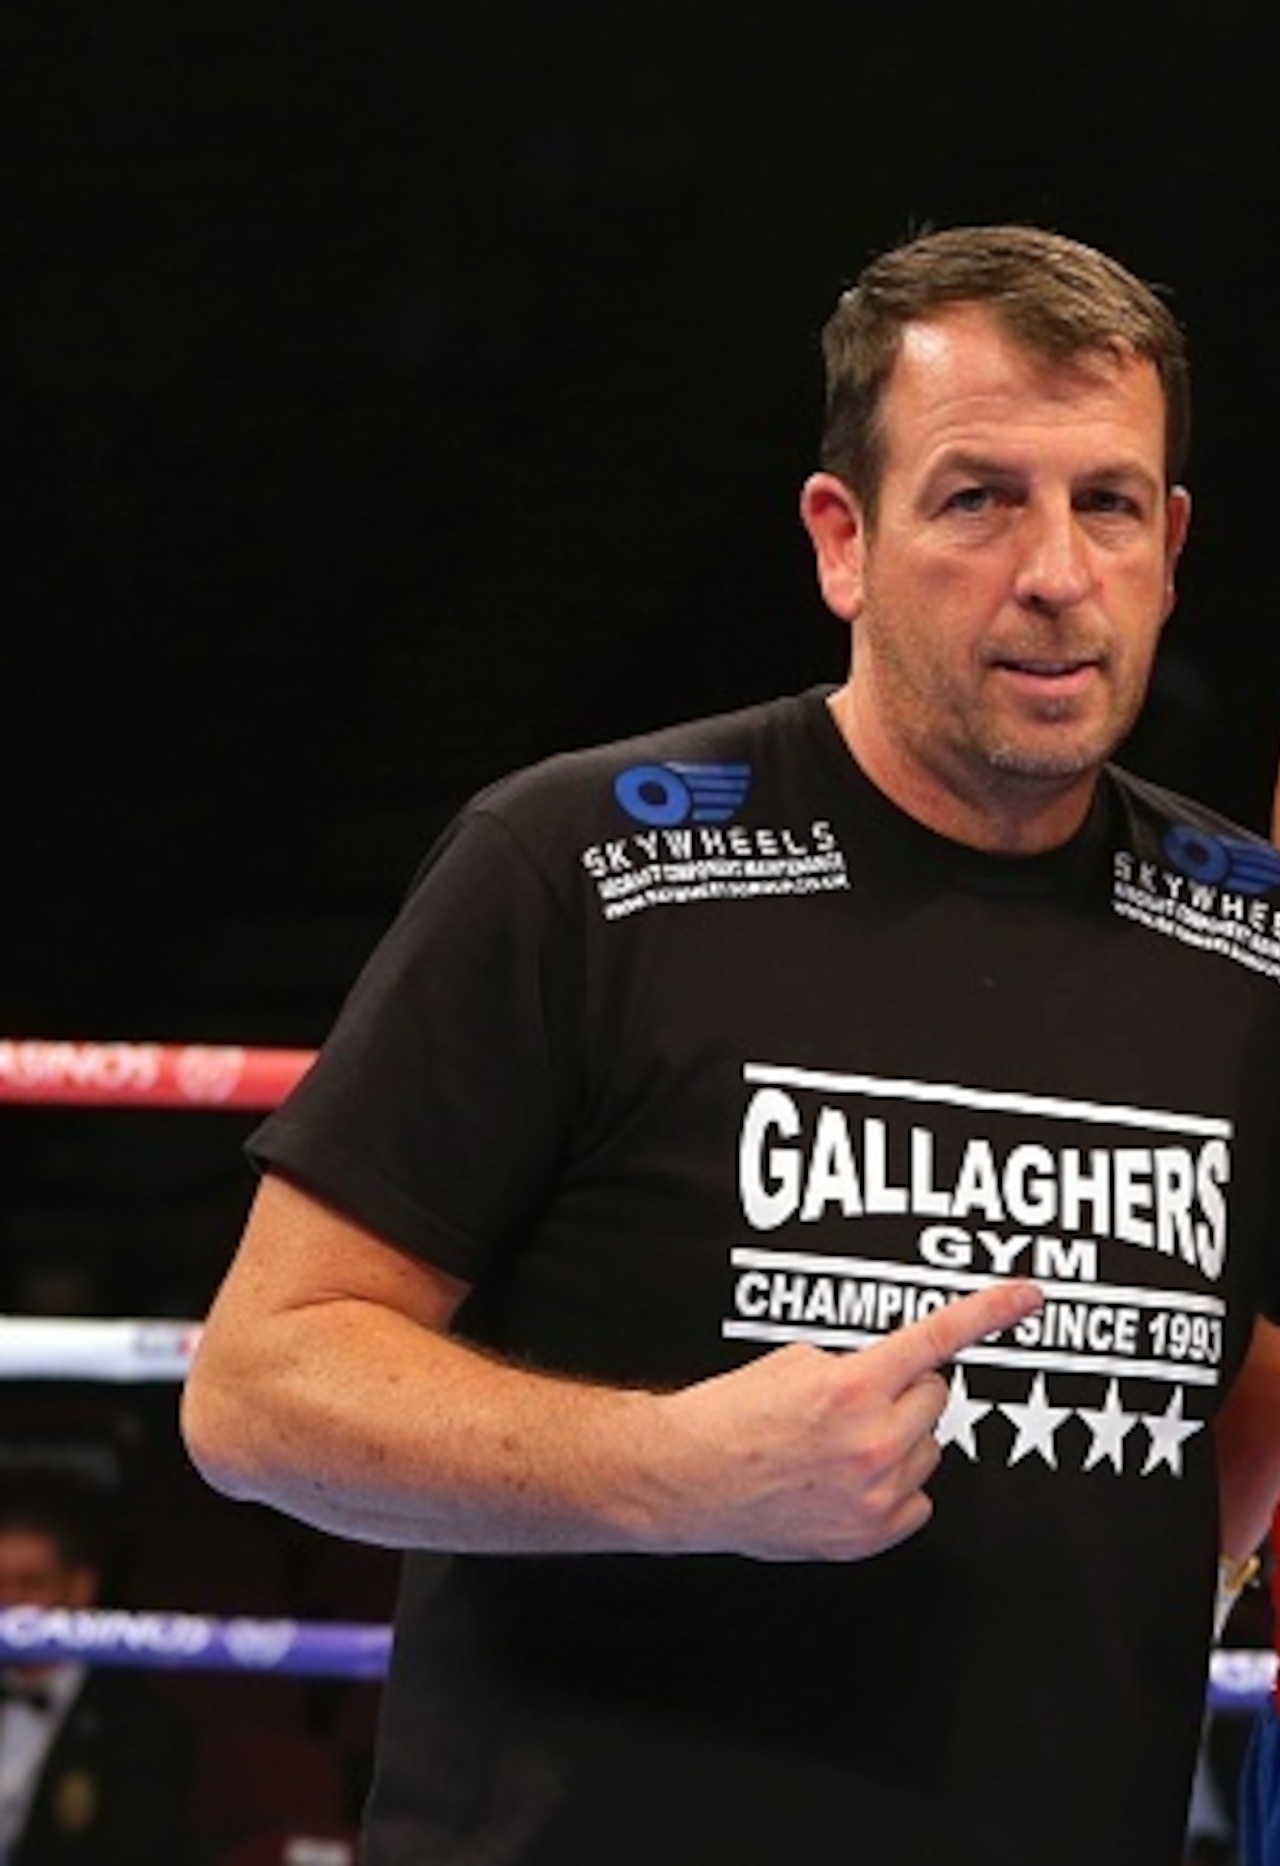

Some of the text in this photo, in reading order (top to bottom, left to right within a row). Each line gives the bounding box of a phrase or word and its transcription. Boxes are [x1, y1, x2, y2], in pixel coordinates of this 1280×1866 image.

[581, 820, 837, 878] SKYWHEELS
[738, 1087, 1232, 1282] GALLAGHERS
[918, 1225, 1098, 1282] GYM
[735, 1271, 1222, 1364] CHAMPIO SINCE 1993
